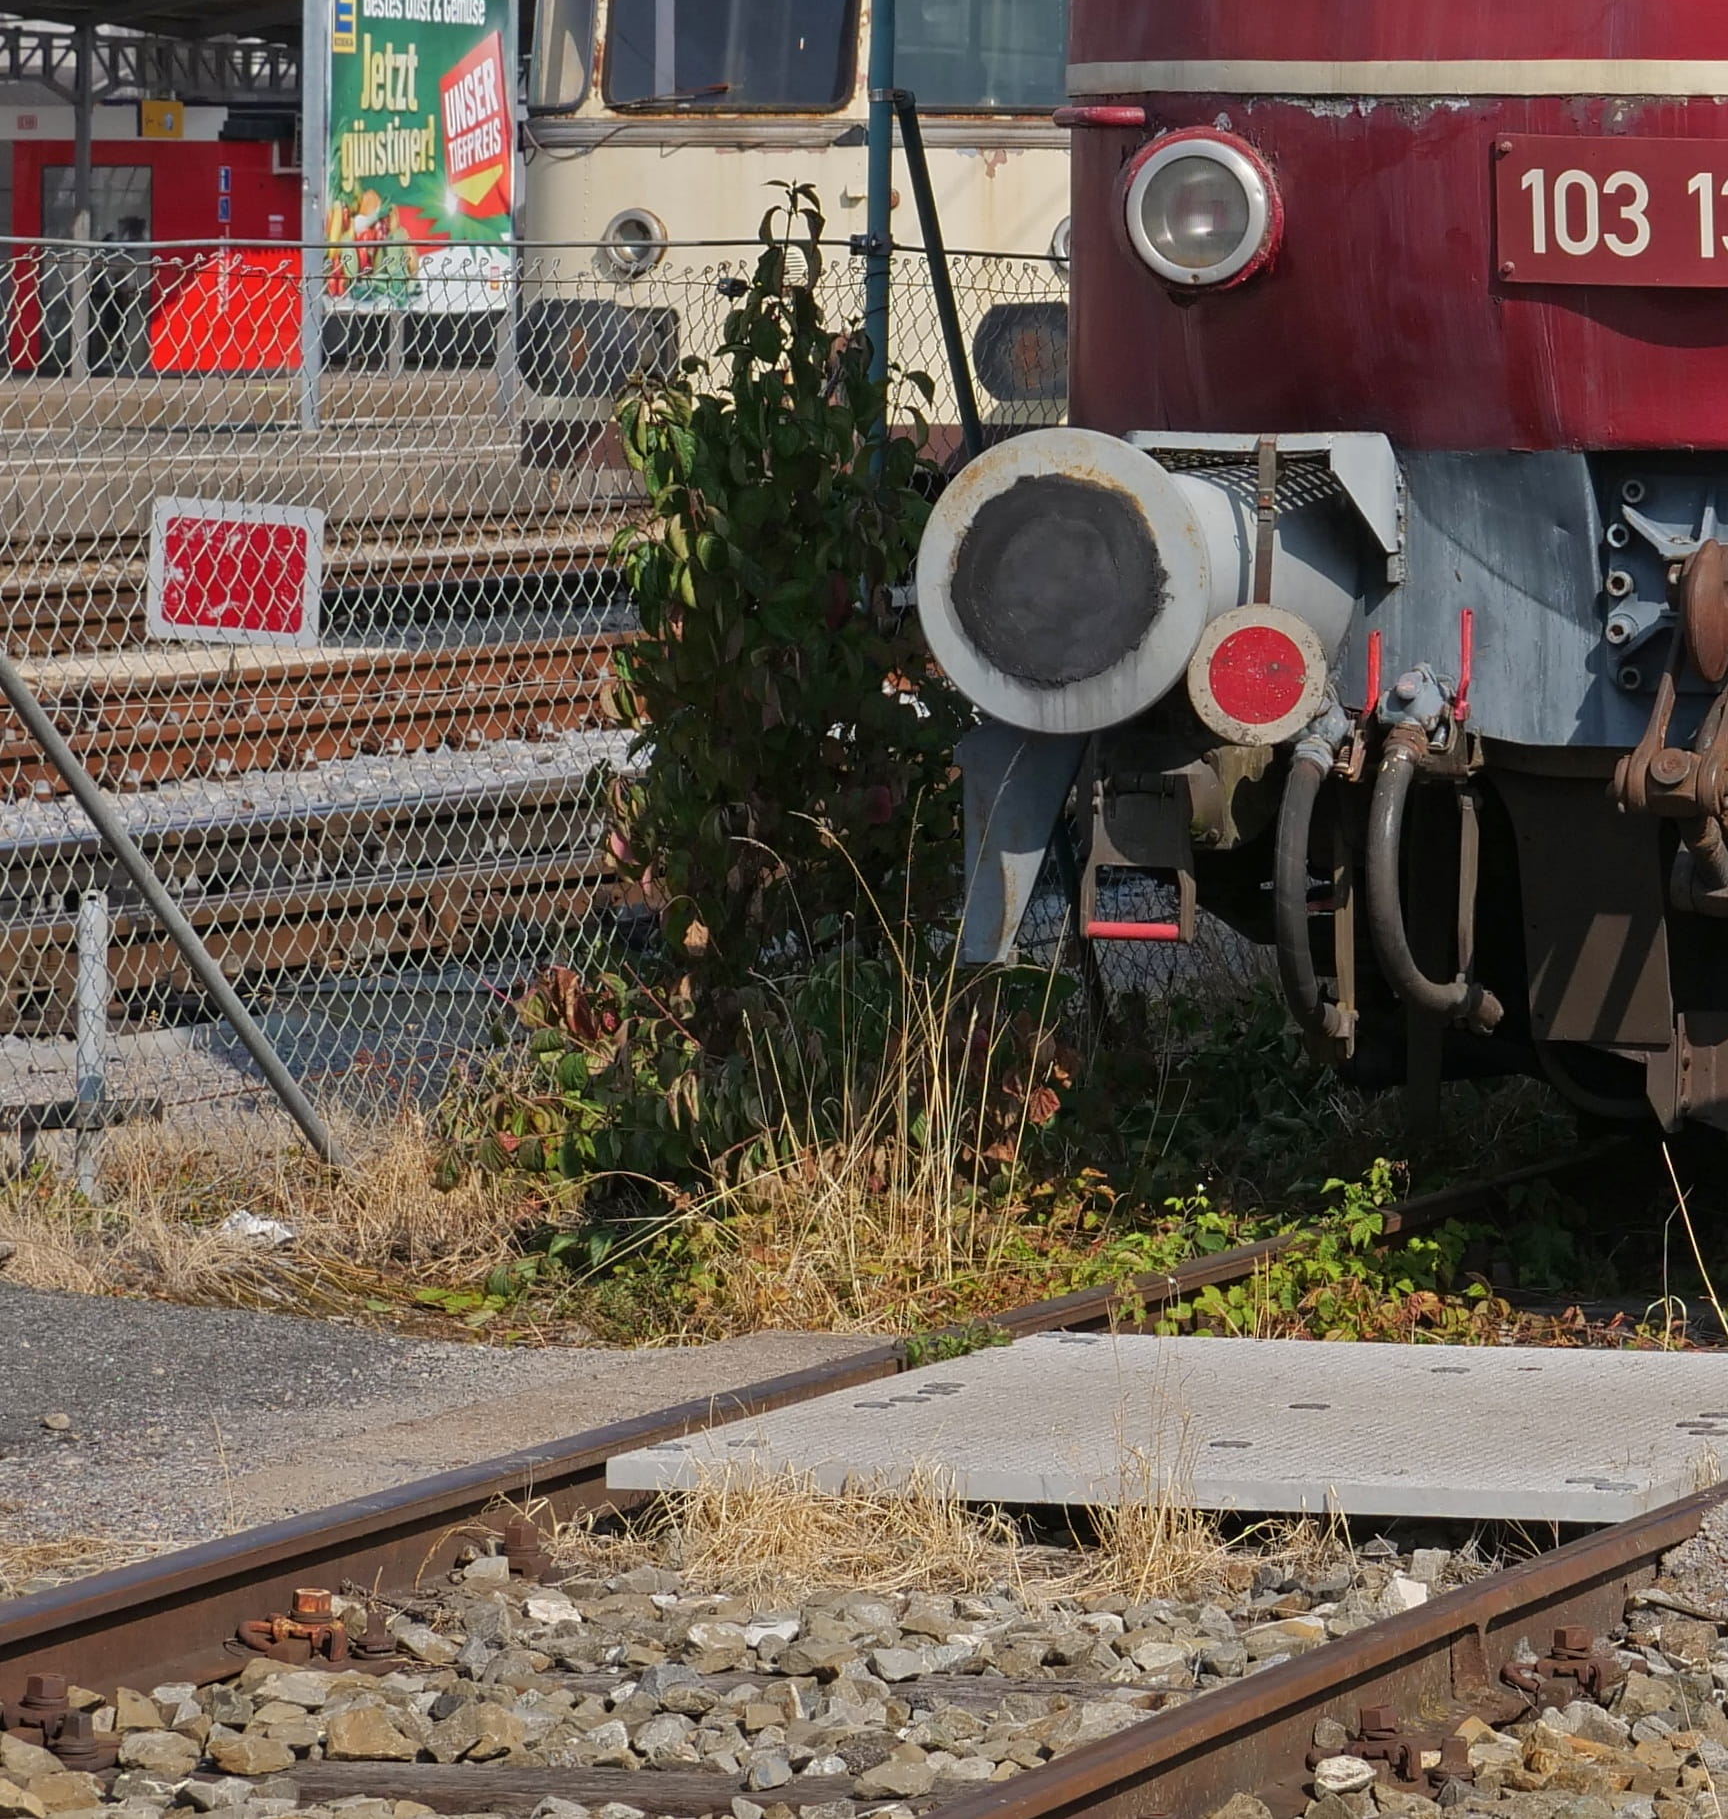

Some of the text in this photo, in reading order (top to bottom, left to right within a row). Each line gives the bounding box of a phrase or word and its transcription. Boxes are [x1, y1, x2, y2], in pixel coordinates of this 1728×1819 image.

[360, 33, 419, 112] Jetzt
[444, 57, 499, 139] UNSER
[341, 114, 435, 194] günstiger!
[448, 117, 502, 175] TIEFPREIS
[1520, 168, 1651, 258] 103
